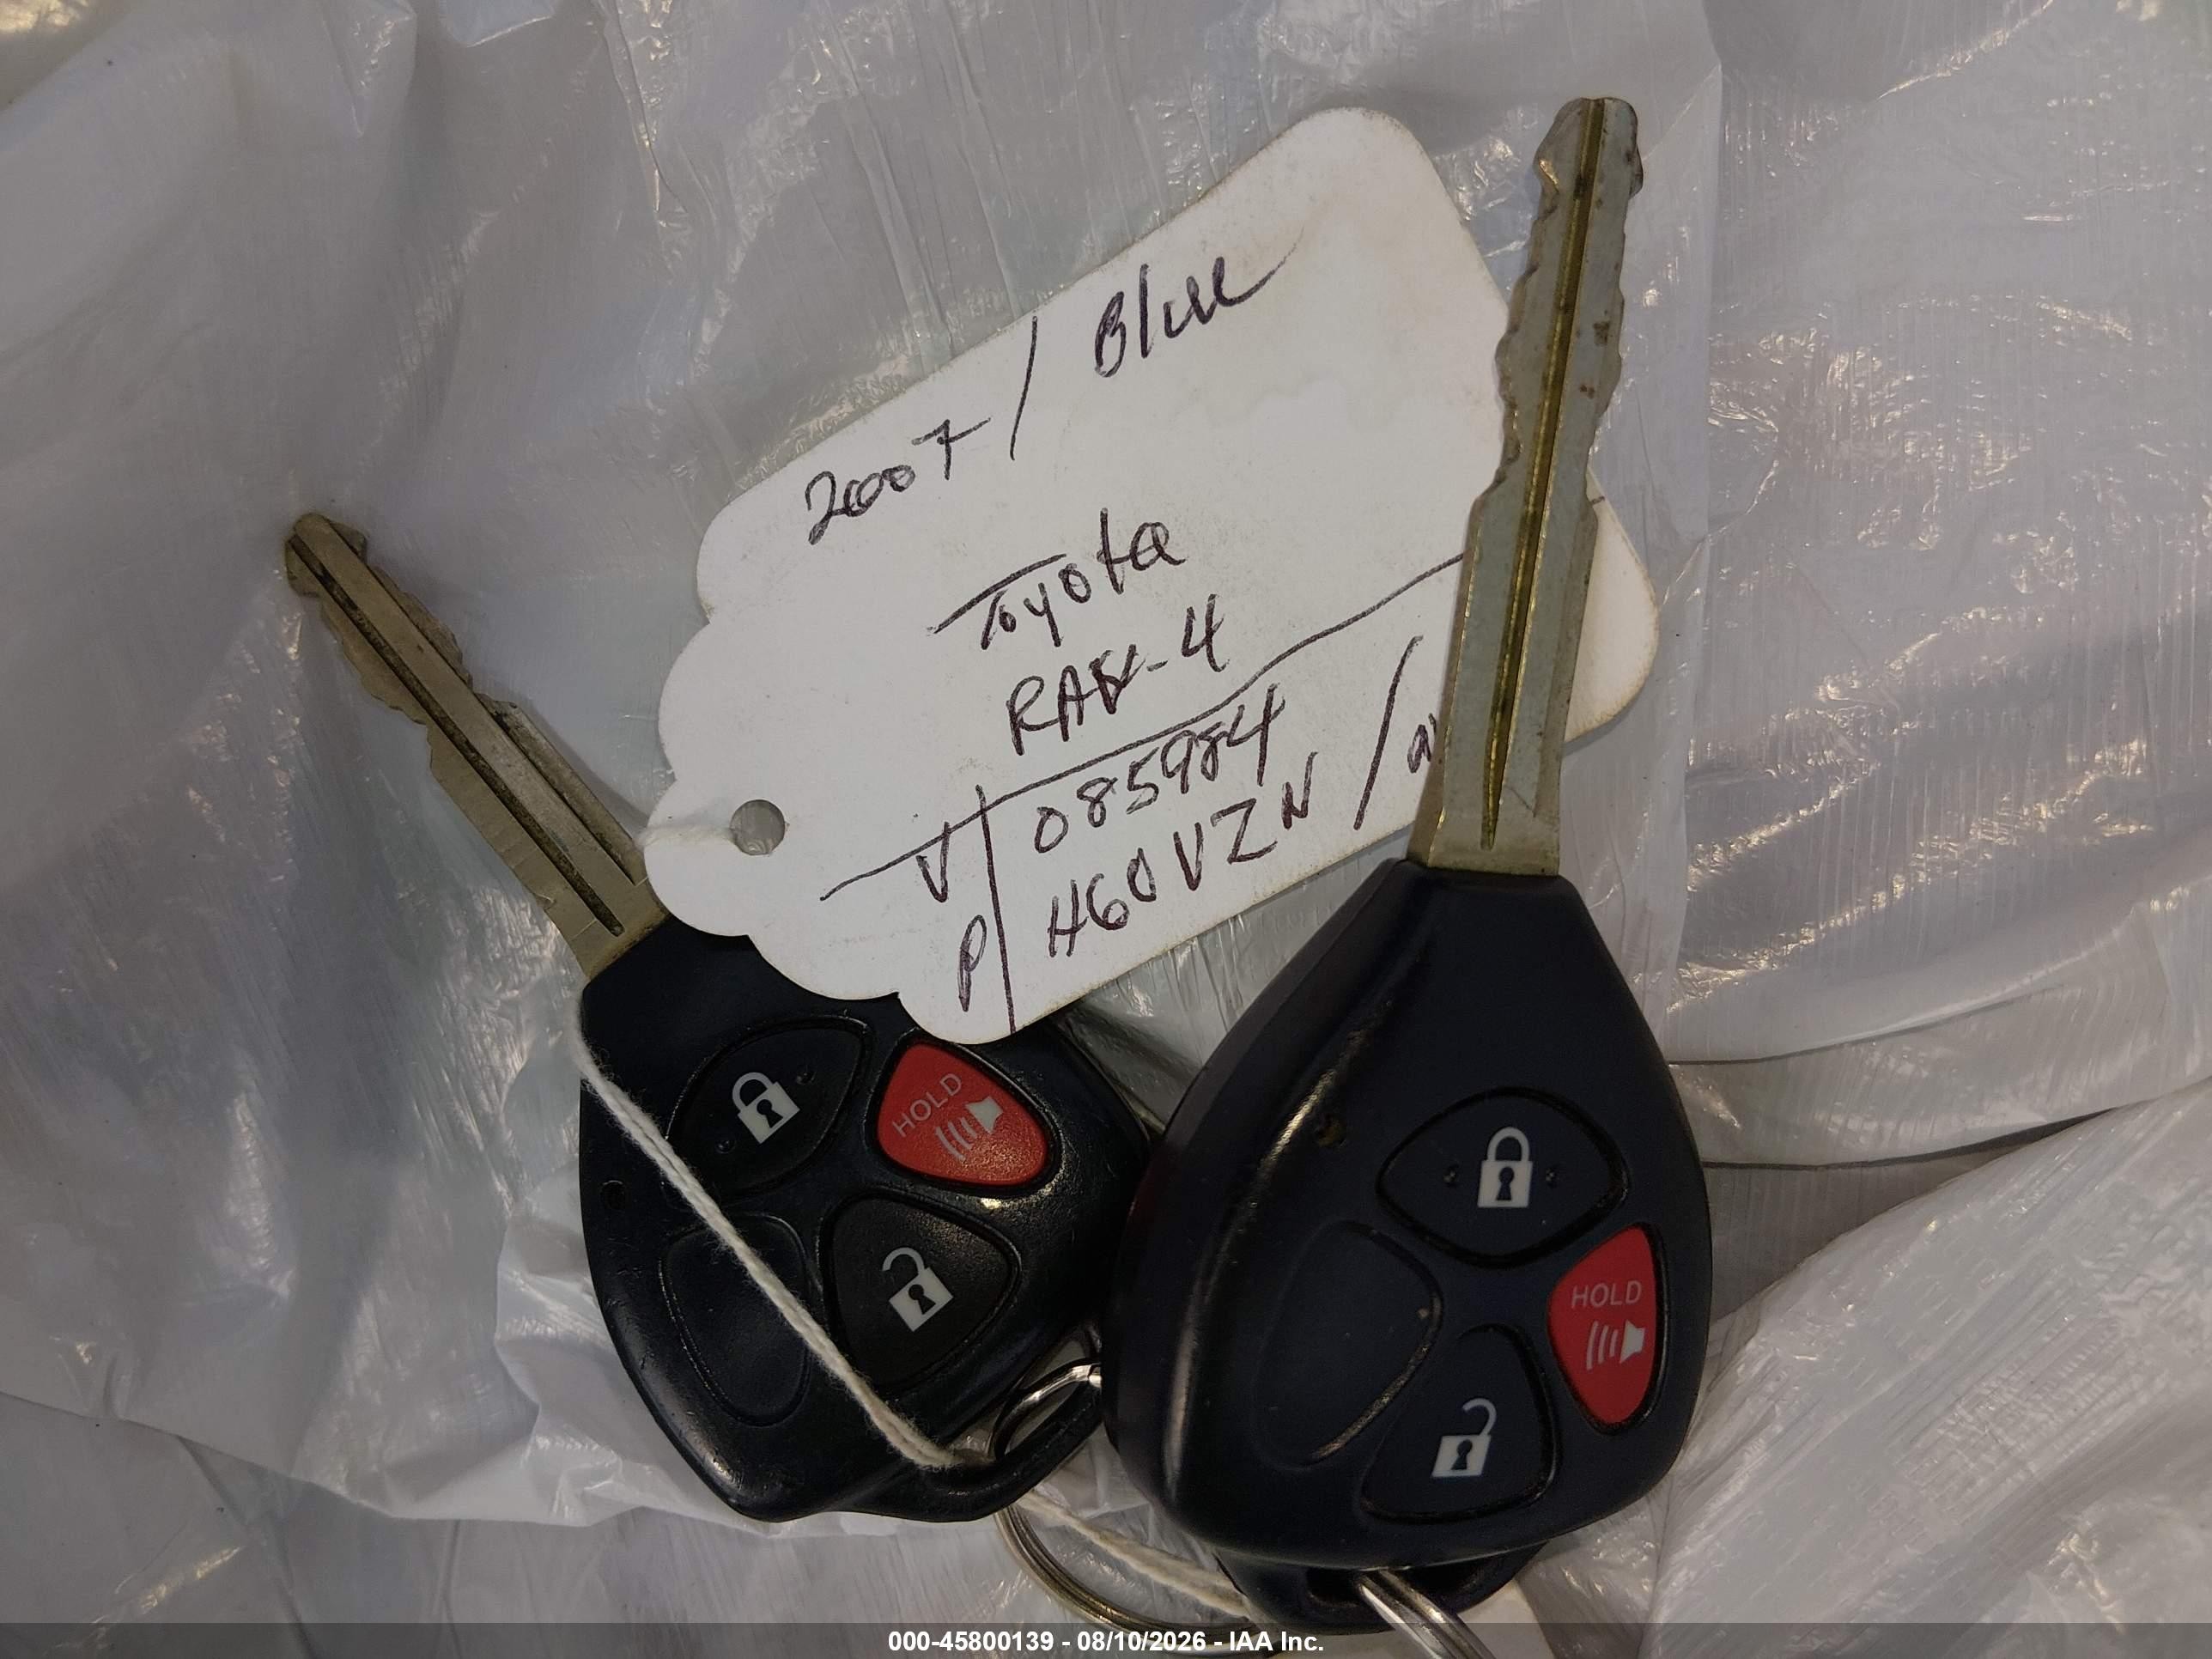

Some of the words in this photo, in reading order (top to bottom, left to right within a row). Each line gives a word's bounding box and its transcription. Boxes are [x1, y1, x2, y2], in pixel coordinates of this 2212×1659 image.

[805, 418, 991, 545] 2007
[1094, 249, 1295, 378] Blue
[928, 507, 1187, 651] Toyota
[892, 1073, 963, 1138] HOLD
[1571, 1279, 1642, 1310] HOLD
